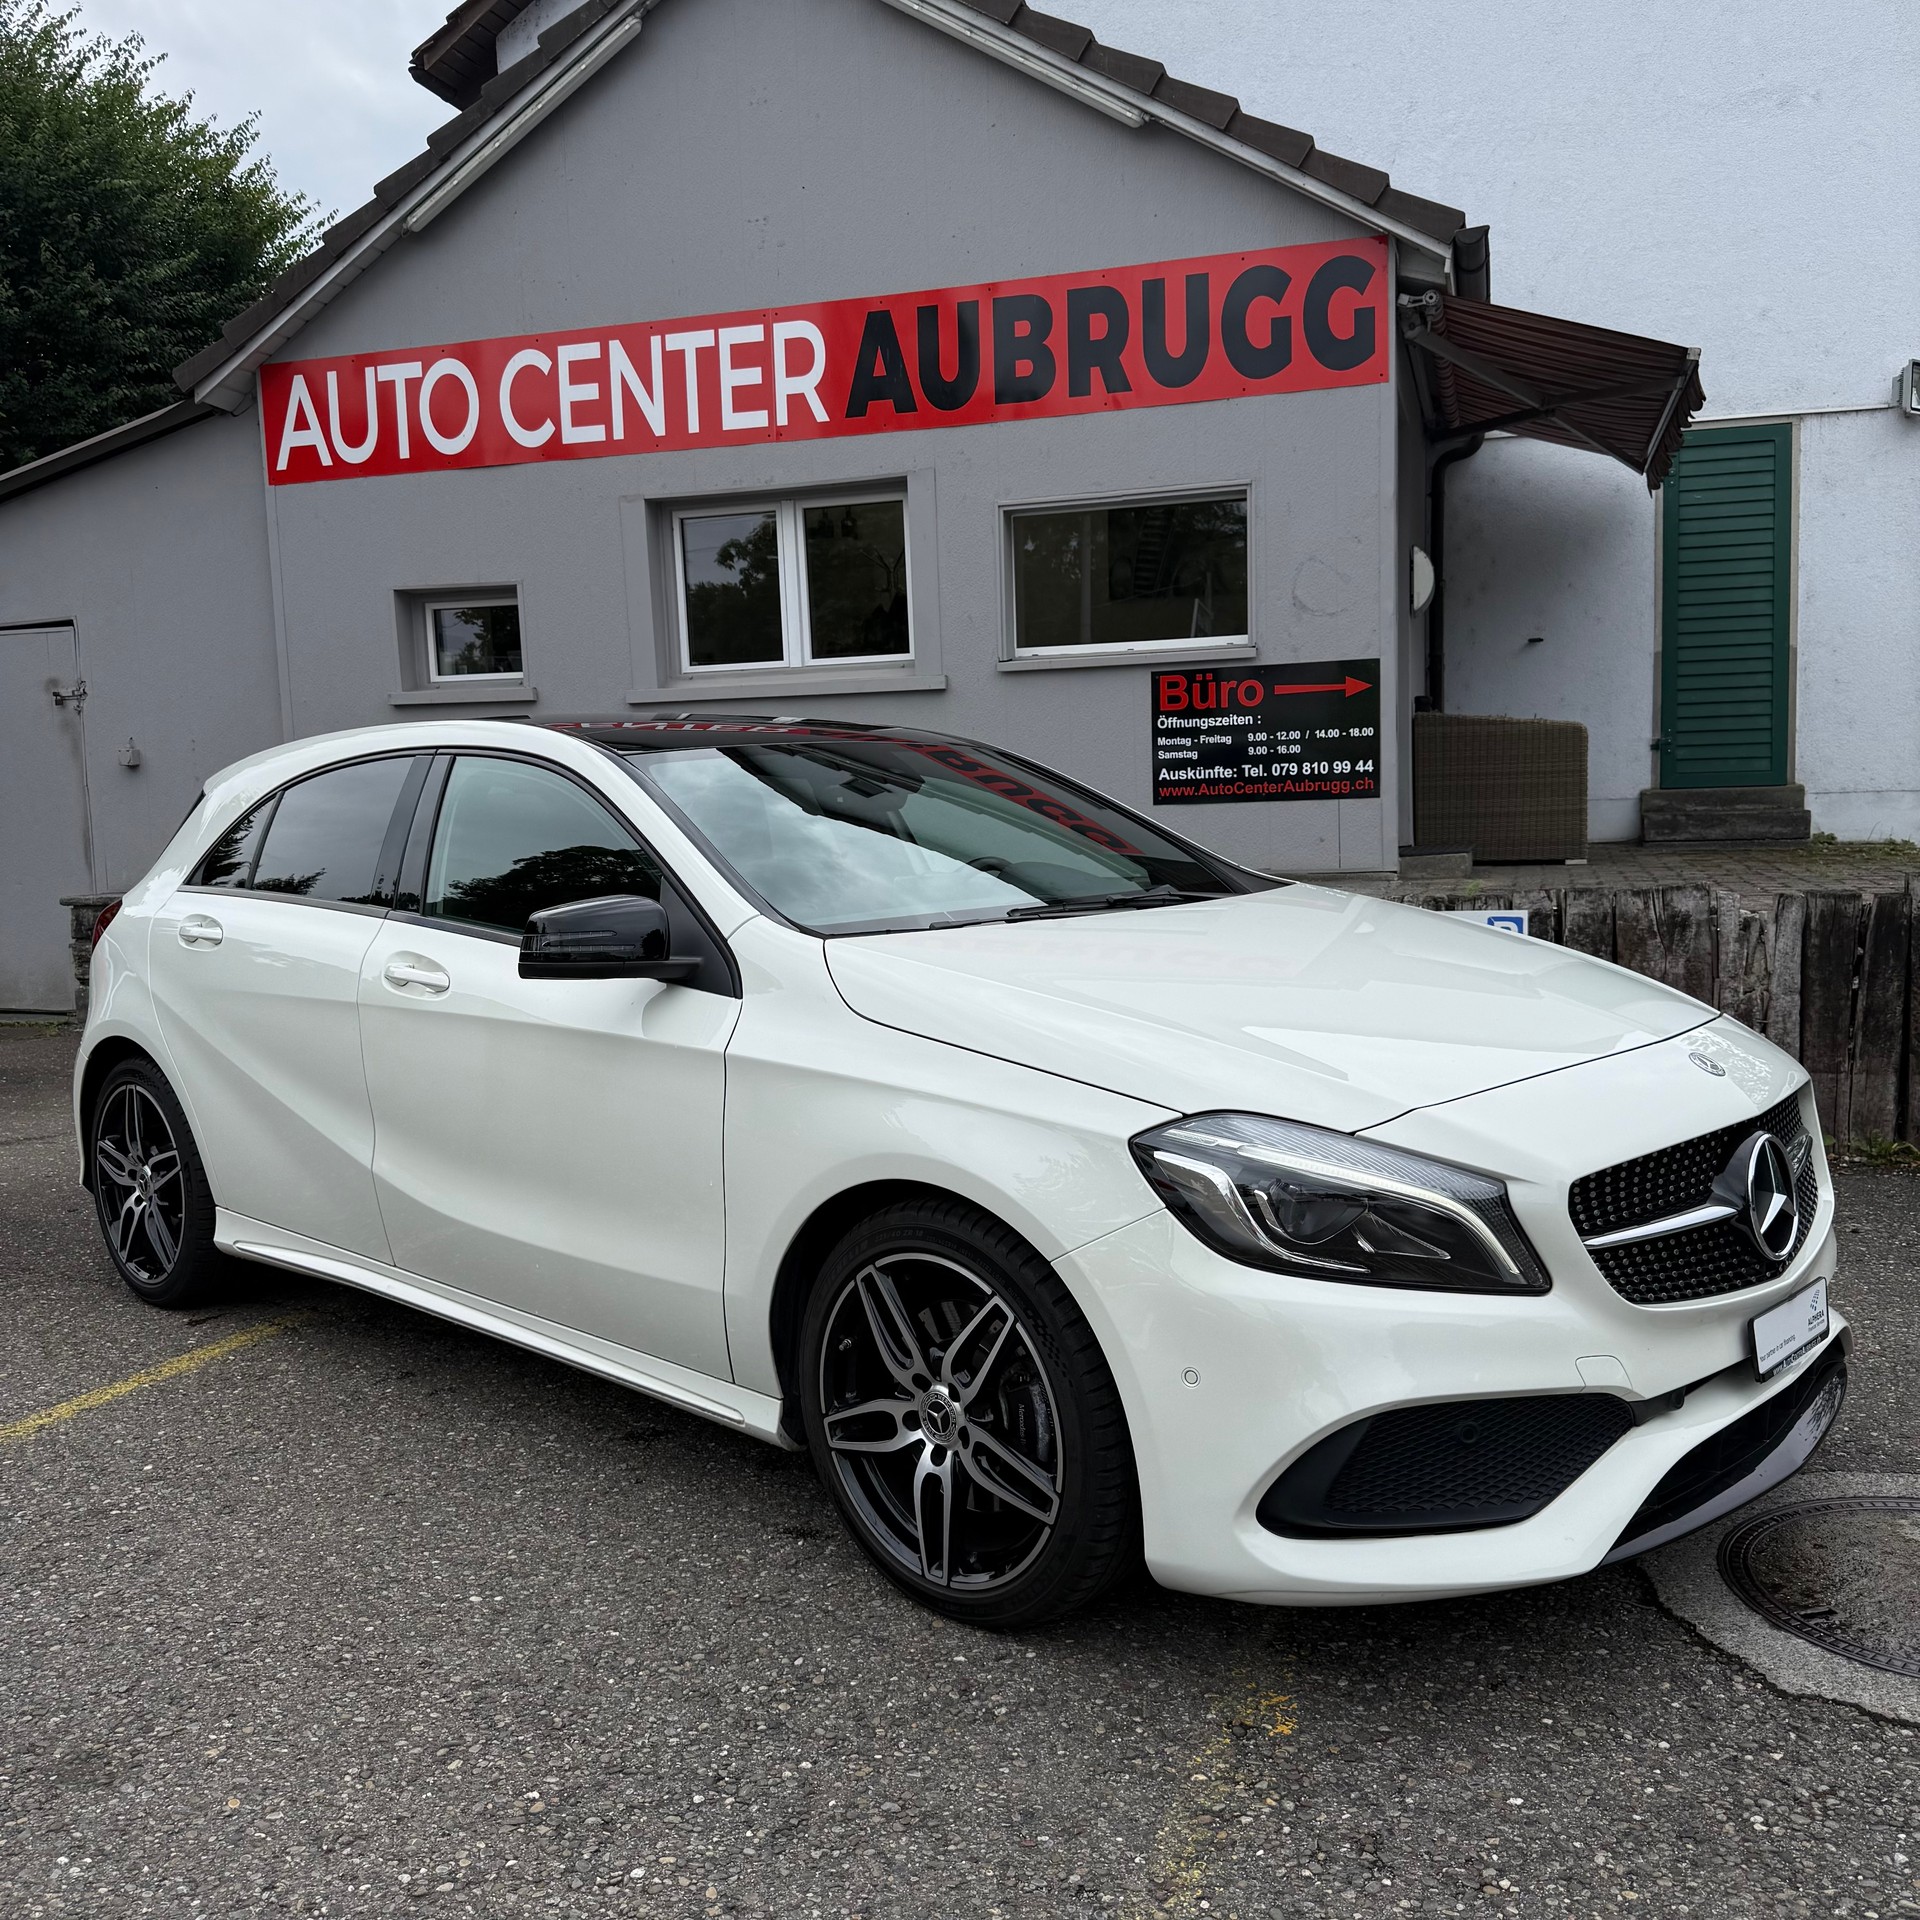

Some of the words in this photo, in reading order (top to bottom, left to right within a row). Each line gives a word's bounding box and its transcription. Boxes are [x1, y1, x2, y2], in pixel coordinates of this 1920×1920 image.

[276, 357, 480, 471] AUTO
[500, 320, 830, 449] CENTER
[844, 254, 1377, 418] AUBRUGG
[1159, 673, 1265, 711] Büro
[1157, 714, 1253, 729] Öffnungszeiten
[1157, 736, 1192, 746] Montag
[1200, 734, 1232, 745] Freitag
[1247, 732, 1268, 742] 9.00
[1276, 730, 1301, 740] 12.00
[1314, 728, 1340, 739] 14.00
[1348, 727, 1374, 737] 18.00
[1158, 750, 1198, 760] Samstag
[1248, 746, 1268, 755] 9.00
[1276, 744, 1301, 754] 16.00
[1159, 765, 1237, 780] Auskünfte:
[1241, 764, 1267, 777] Tel.
[1271, 763, 1298, 776] 079
[1302, 761, 1329, 775] 810
[1333, 760, 1351, 773] 99
[1355, 759, 1374, 773] 44
[1159, 777, 1374, 796] www.AutoCenterAubrugg.ch
